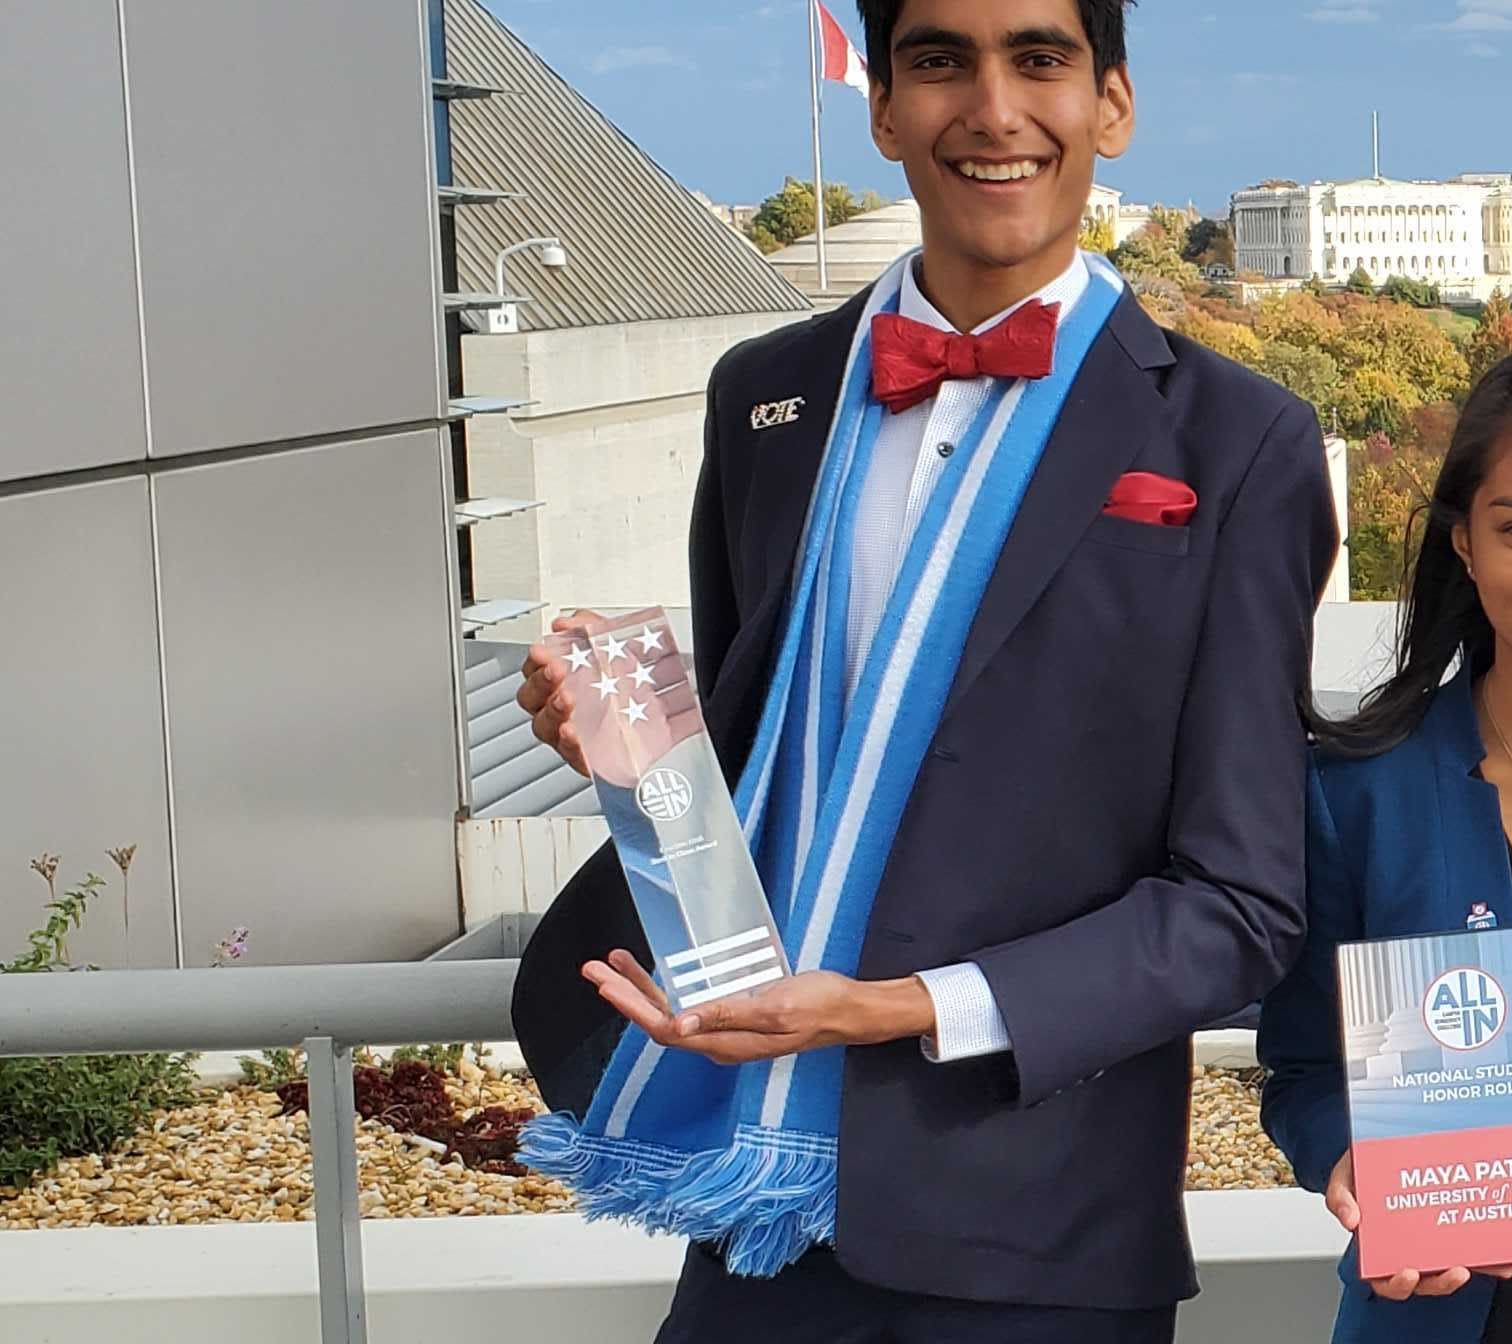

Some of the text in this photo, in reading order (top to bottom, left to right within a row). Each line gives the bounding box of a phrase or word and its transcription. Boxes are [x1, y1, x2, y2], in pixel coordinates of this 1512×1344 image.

[751, 396, 806, 429] VOTE
[643, 772, 684, 800] ALL
[663, 790, 689, 816] IN
[1432, 972, 1497, 1011] ALL
[1462, 1008, 1498, 1046] IN
[1392, 1069, 1473, 1088] NATIONAL
[1423, 1085, 1481, 1103] HONOR
[1400, 1164, 1471, 1189] MAYA
[1386, 1187, 1487, 1210] UNIVERSITY
[1491, 1183, 1509, 1205] of
[1437, 1209, 1459, 1226] AT
